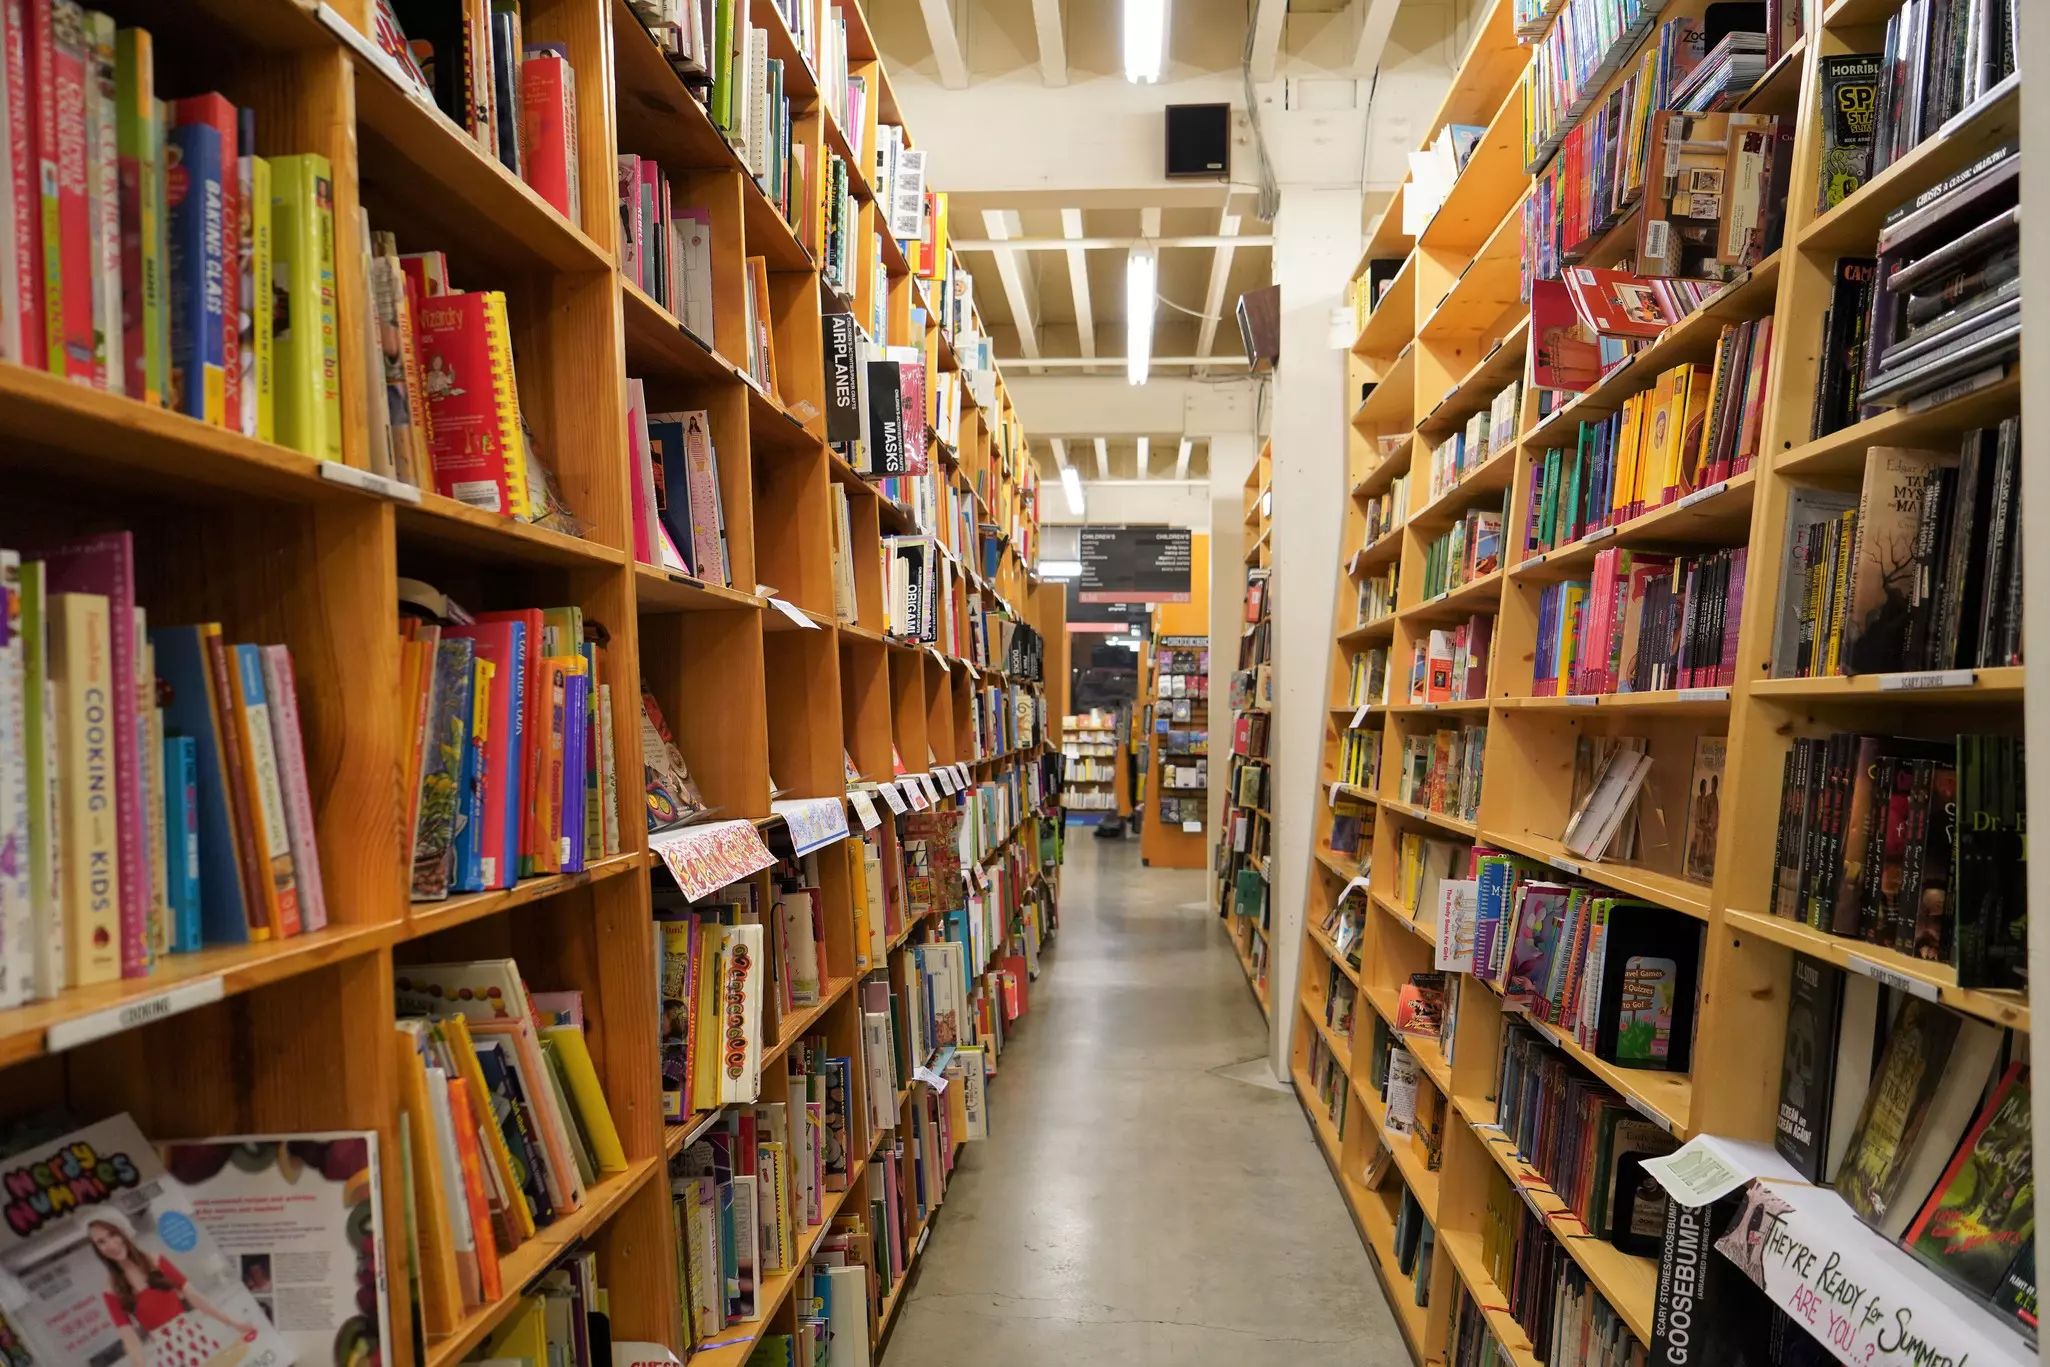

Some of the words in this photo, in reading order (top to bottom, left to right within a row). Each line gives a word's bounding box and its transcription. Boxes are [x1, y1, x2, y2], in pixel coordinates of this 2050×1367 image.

[204, 179, 222, 255] BAKING
[222, 191, 238, 265] LOOK
[206, 260, 223, 315] CLASS
[222, 324, 240, 399] COOK
[832, 317, 850, 408] AIRPLANES
[884, 421, 899, 472] MASKS
[906, 584, 918, 634] ORIGAMI
[86, 687, 108, 812] COOKING
[90, 851, 112, 913] KIDS
[1443, 918, 1451, 935] Book
[1444, 901, 1453, 918] Body
[1628, 983, 1654, 995] Quizzes
[1640, 969, 1663, 978] Games
[1632, 1001, 1645, 1009] Go!
[1779, 1102, 1799, 1123] SCREAM
[1793, 1124, 1812, 1147] AGAIN!
[1702, 1228, 1711, 1251] SERIES
[1667, 1202, 1701, 1366] GOOSEBUMPS
[1762, 1210, 1817, 1280] THEY'RE
[1814, 1251, 1867, 1315] READY
[1858, 1296, 1884, 1334] for
[2009, 1274, 2028, 1291] PLANET
[1657, 1305, 1668, 1337] SCARY
[1788, 1282, 1823, 1326] ARE
